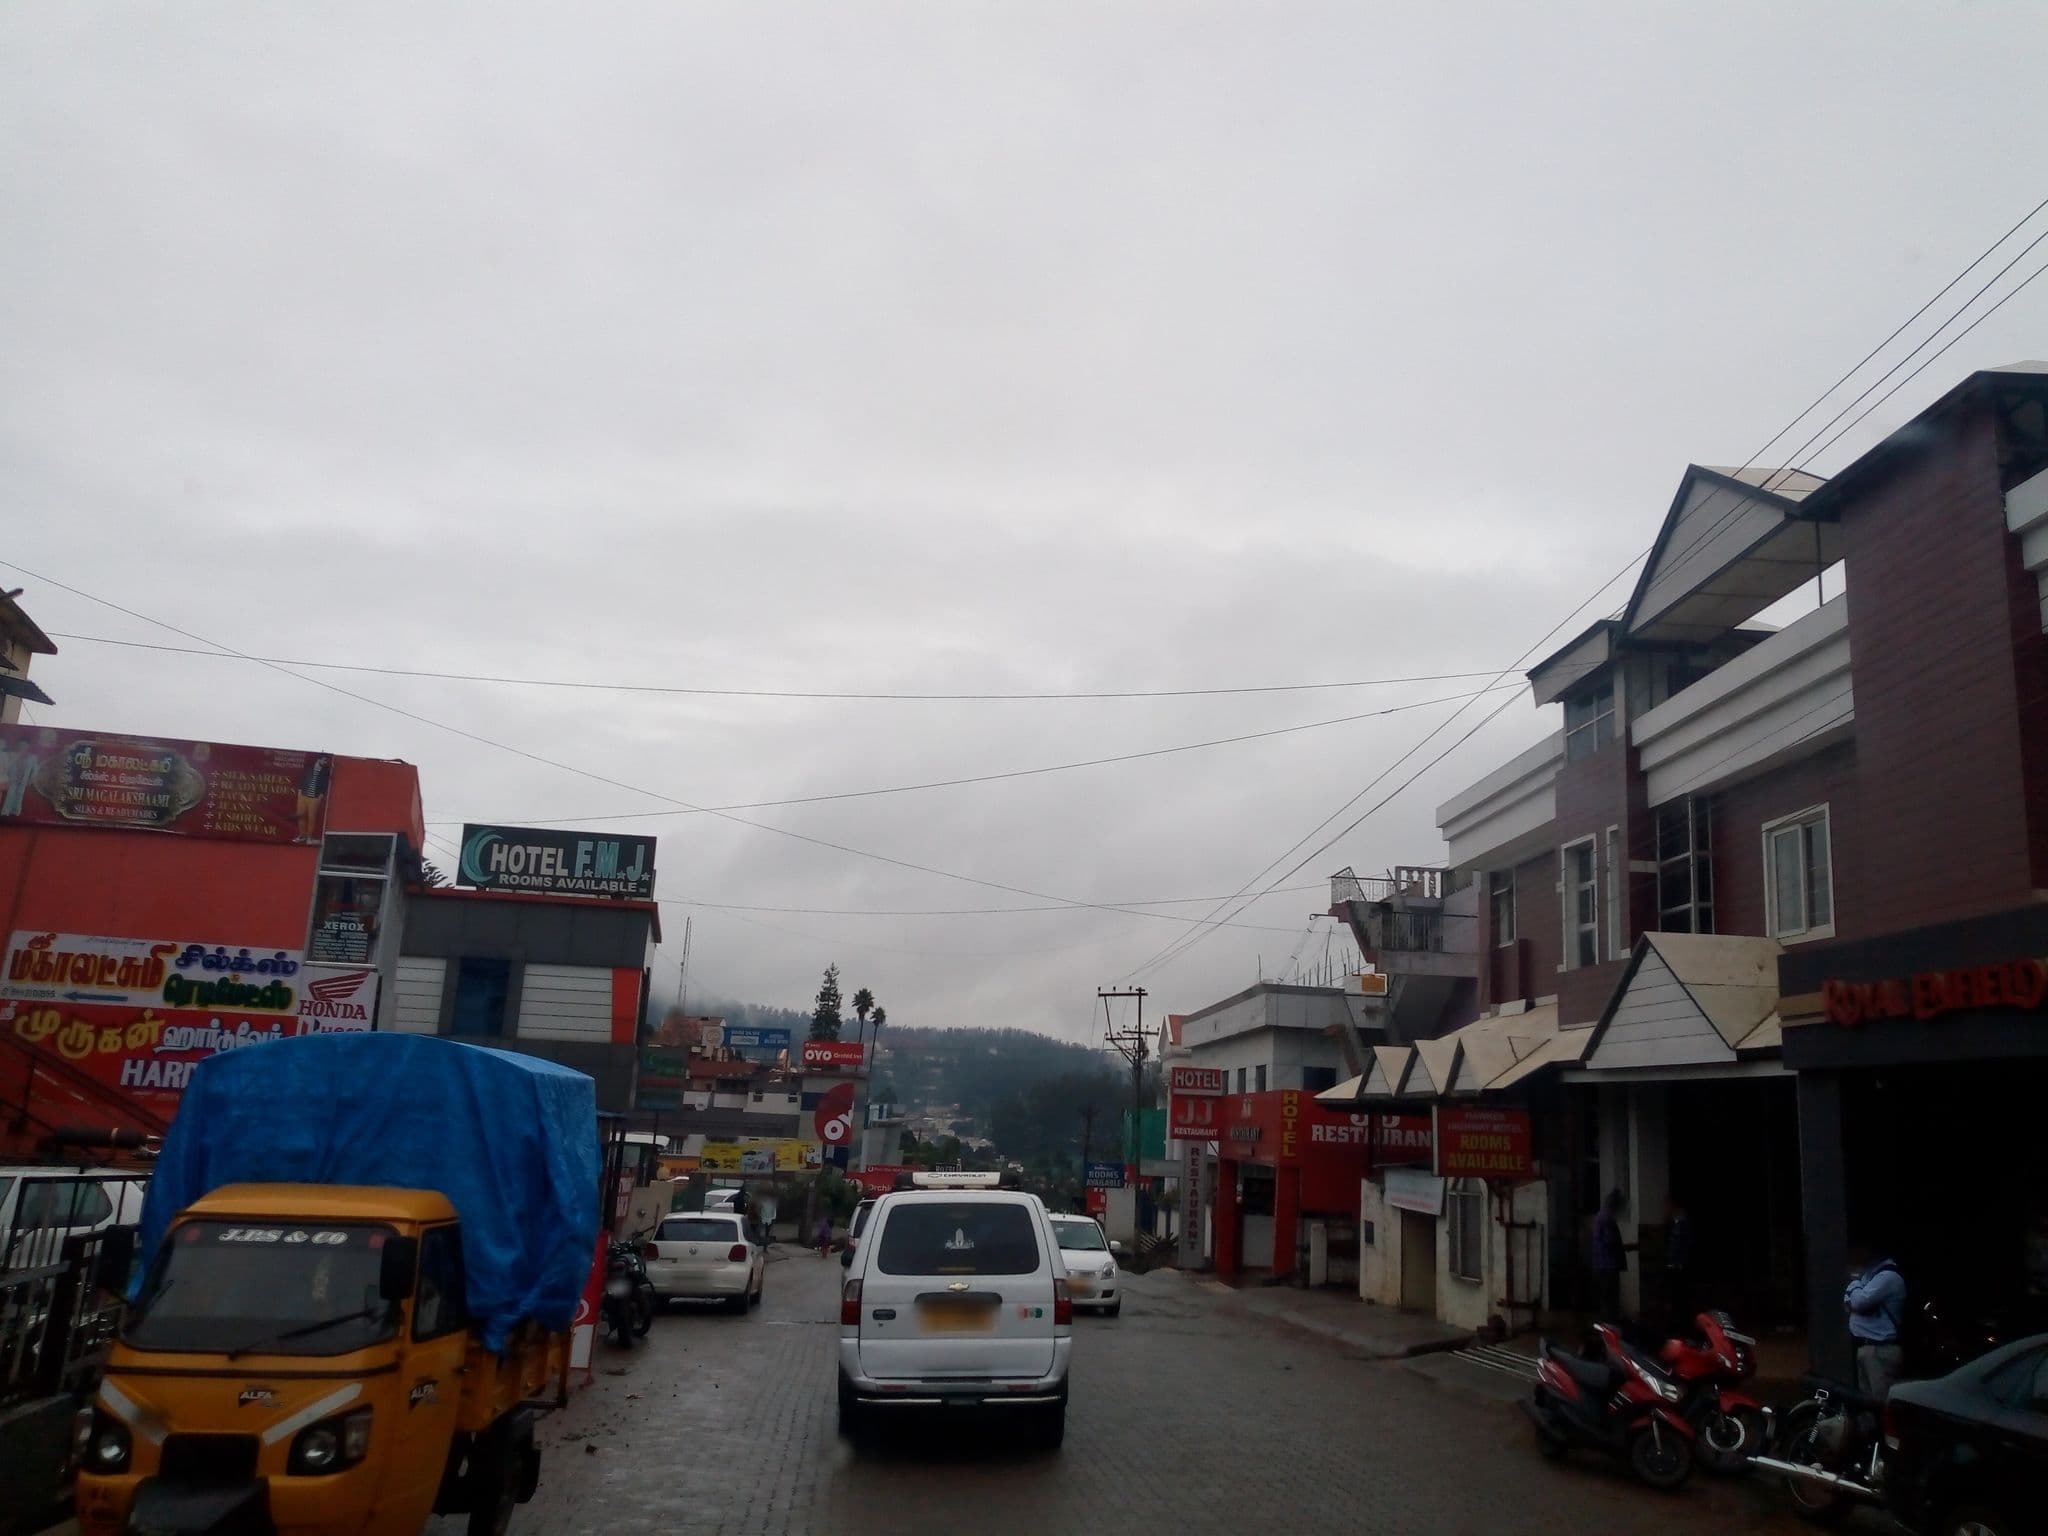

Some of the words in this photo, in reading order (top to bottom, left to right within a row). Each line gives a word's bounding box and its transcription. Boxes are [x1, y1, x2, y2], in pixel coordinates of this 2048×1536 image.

[489, 843, 569, 877] HOTEL
[499, 874, 553, 887] ROOMS
[556, 878, 638, 893] AVAILABLE
[324, 920, 366, 931] XEROX
[297, 1000, 368, 1020] HONDA
[805, 1049, 832, 1061] OYO
[1174, 1070, 1220, 1088] HOTEL
[1177, 1099, 1216, 1126] JJ
[1174, 1127, 1218, 1136] RESTAURANT
[1282, 1091, 1298, 1158] HOTEL
[1460, 1135, 1512, 1151] ROOMS
[1447, 1153, 1526, 1170] AVAILABLE
[1088, 1170, 1120, 1179] ROOMS
[1086, 1179, 1122, 1187] AVAILABLE
[1188, 1147, 1200, 1249] RESTAURANT
[284, 1230, 309, 1243] &
[240, 1390, 273, 1400] ALFA
[410, 1384, 435, 1400] ALFA
